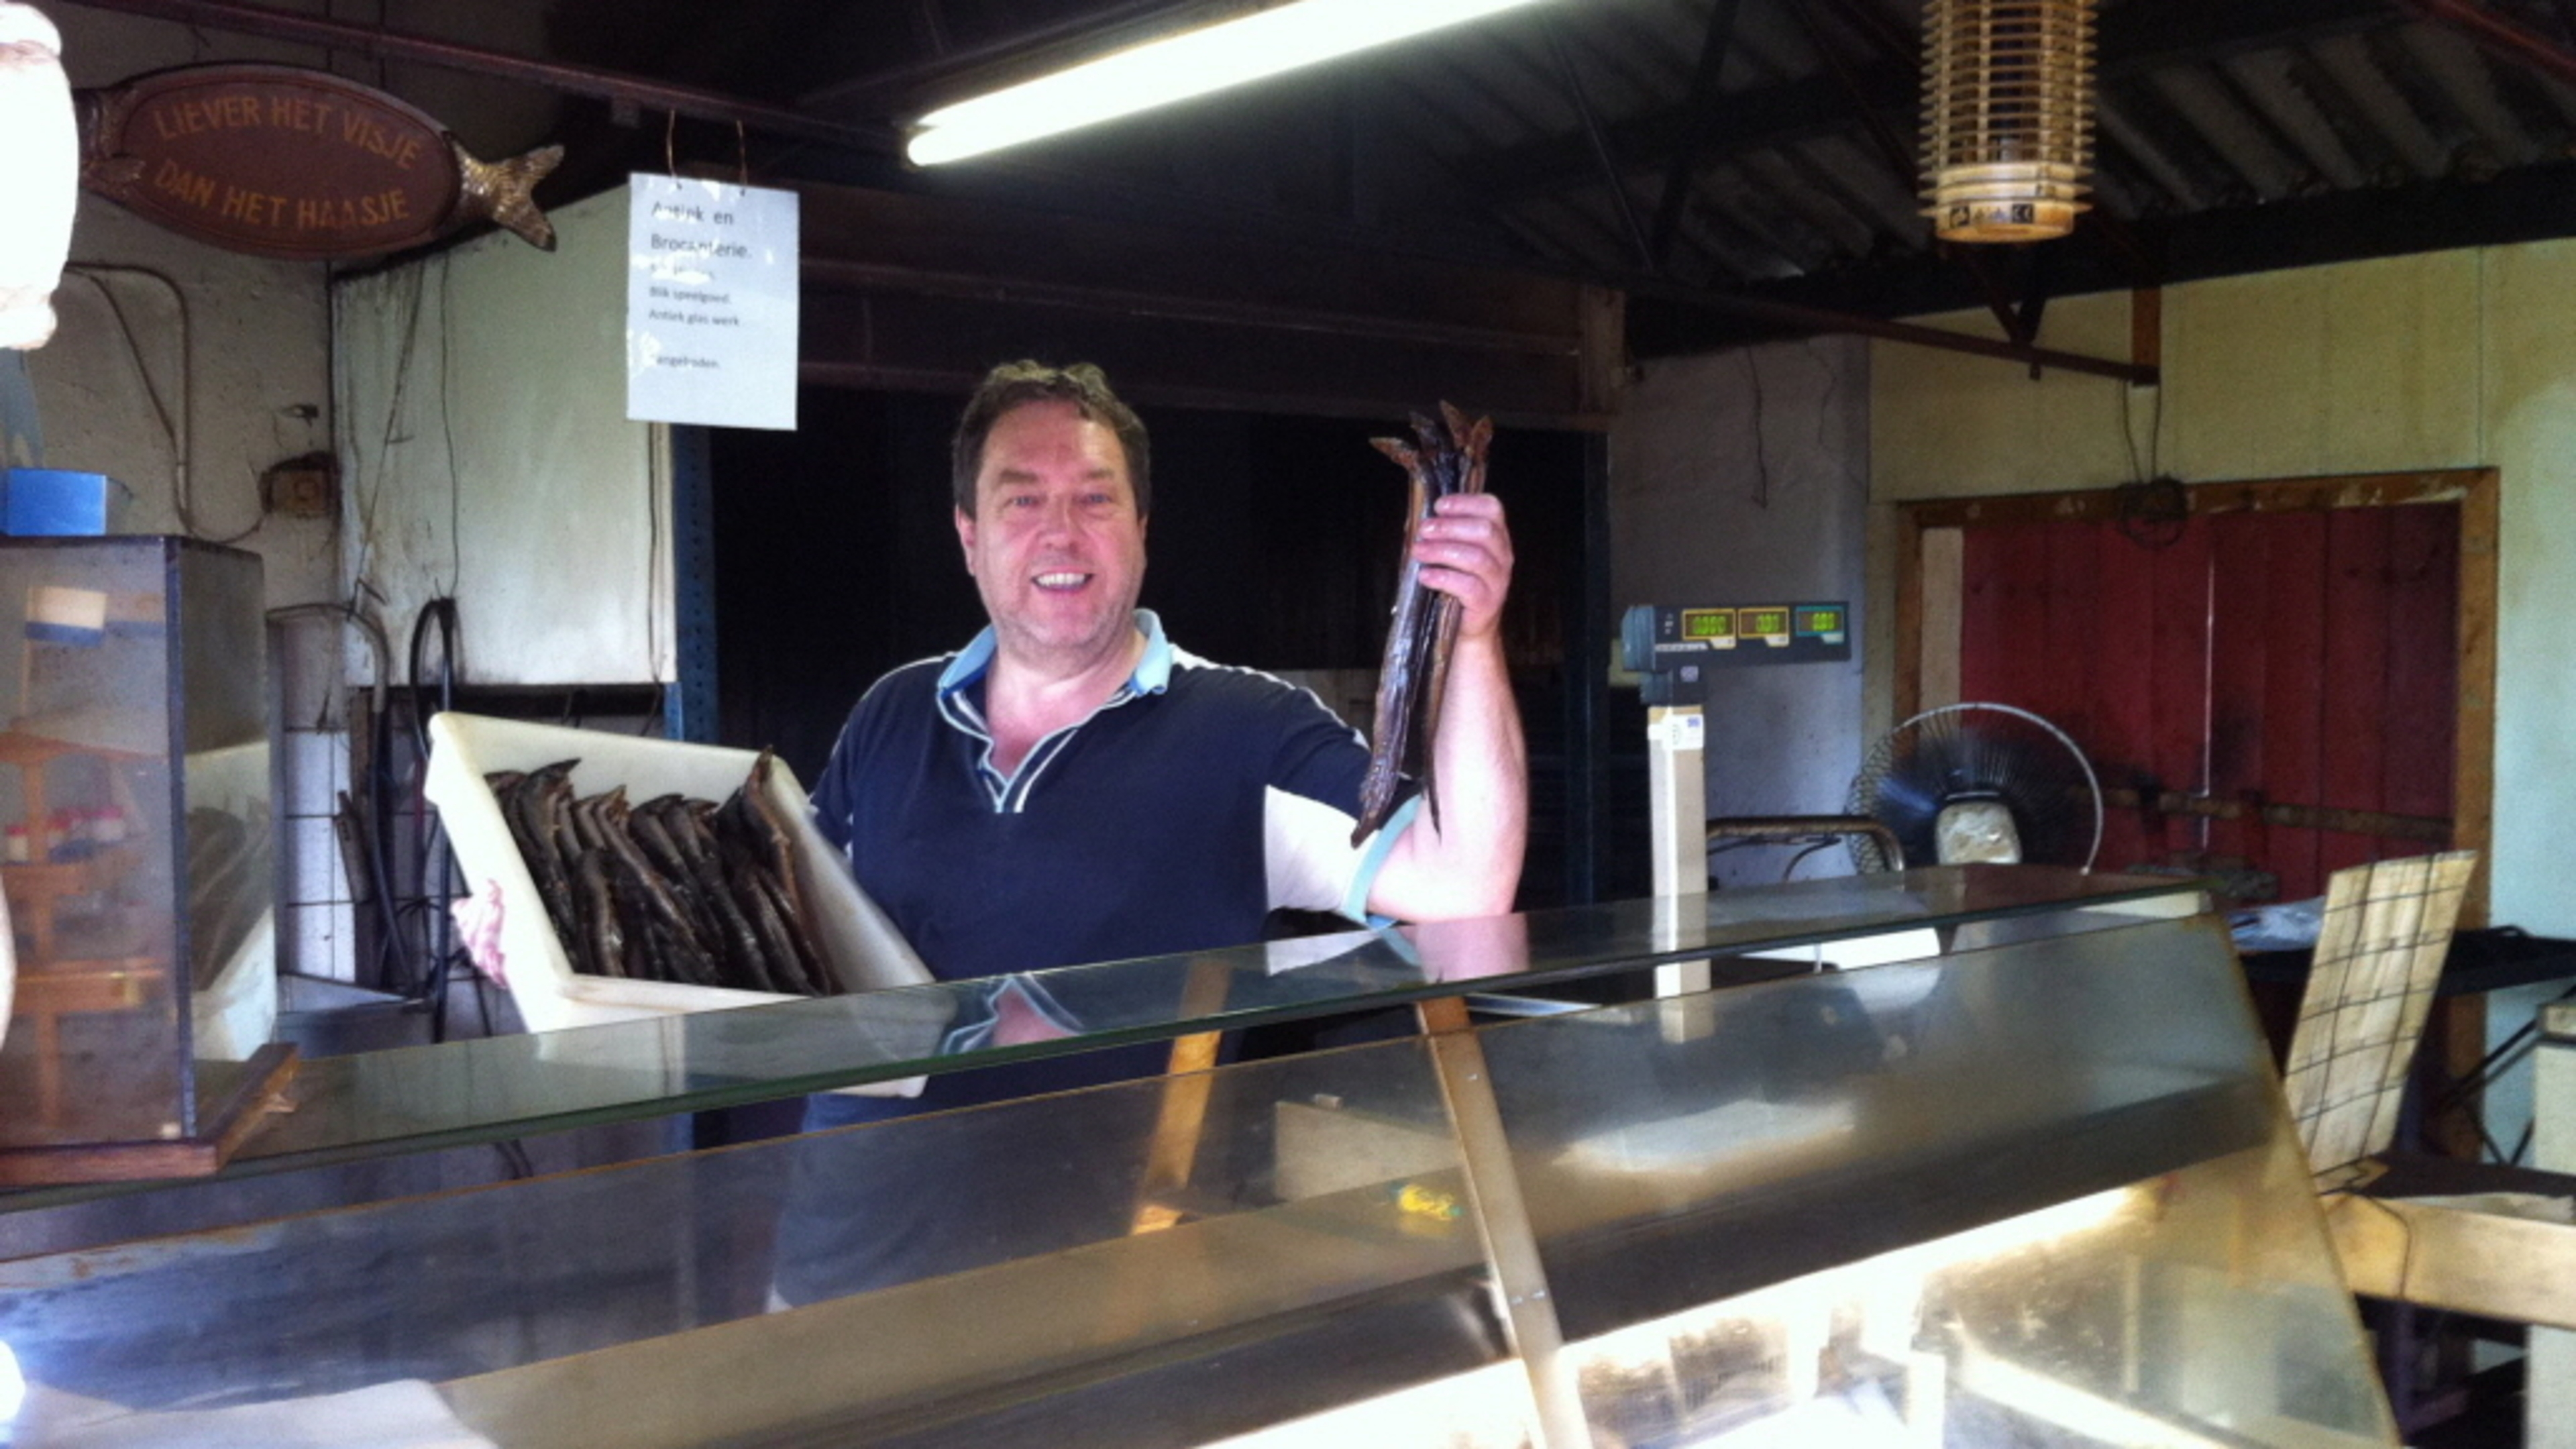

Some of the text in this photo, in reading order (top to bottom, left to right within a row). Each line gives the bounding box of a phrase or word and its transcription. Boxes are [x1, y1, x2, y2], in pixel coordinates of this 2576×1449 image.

[154, 95, 422, 170] LIEVER HET VISJE
[154, 157, 411, 230] DAN HET HAASJE
[713, 211, 734, 225] en
